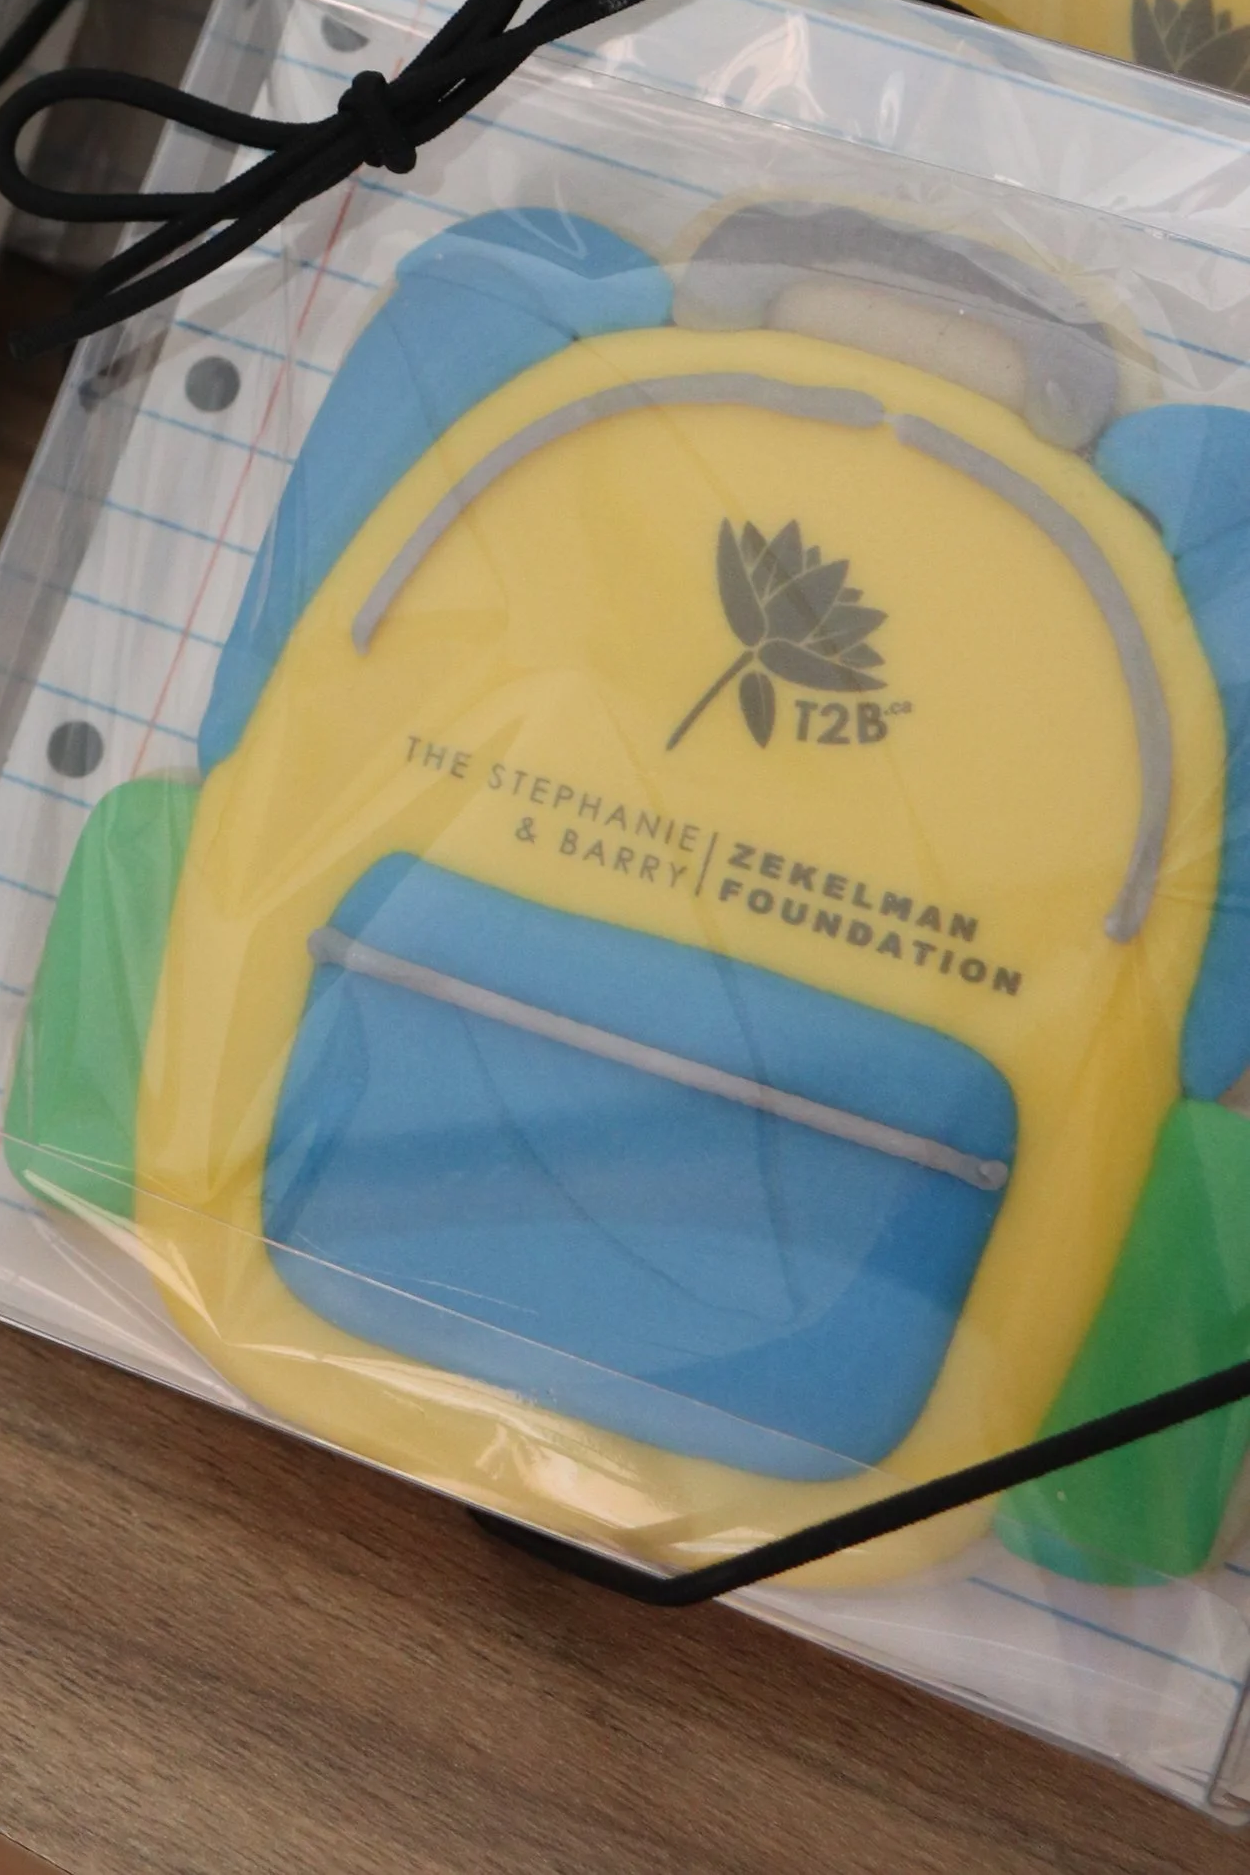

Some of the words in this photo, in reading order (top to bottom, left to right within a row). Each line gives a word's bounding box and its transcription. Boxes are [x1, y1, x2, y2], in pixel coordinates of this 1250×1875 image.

[405, 735, 472, 780] THE
[487, 762, 701, 853] STEPHANIE
[513, 815, 537, 844] &
[558, 827, 688, 889] BARRY
[727, 841, 980, 943] ZEKELMAN
[717, 877, 1024, 998] FOUNDATION
